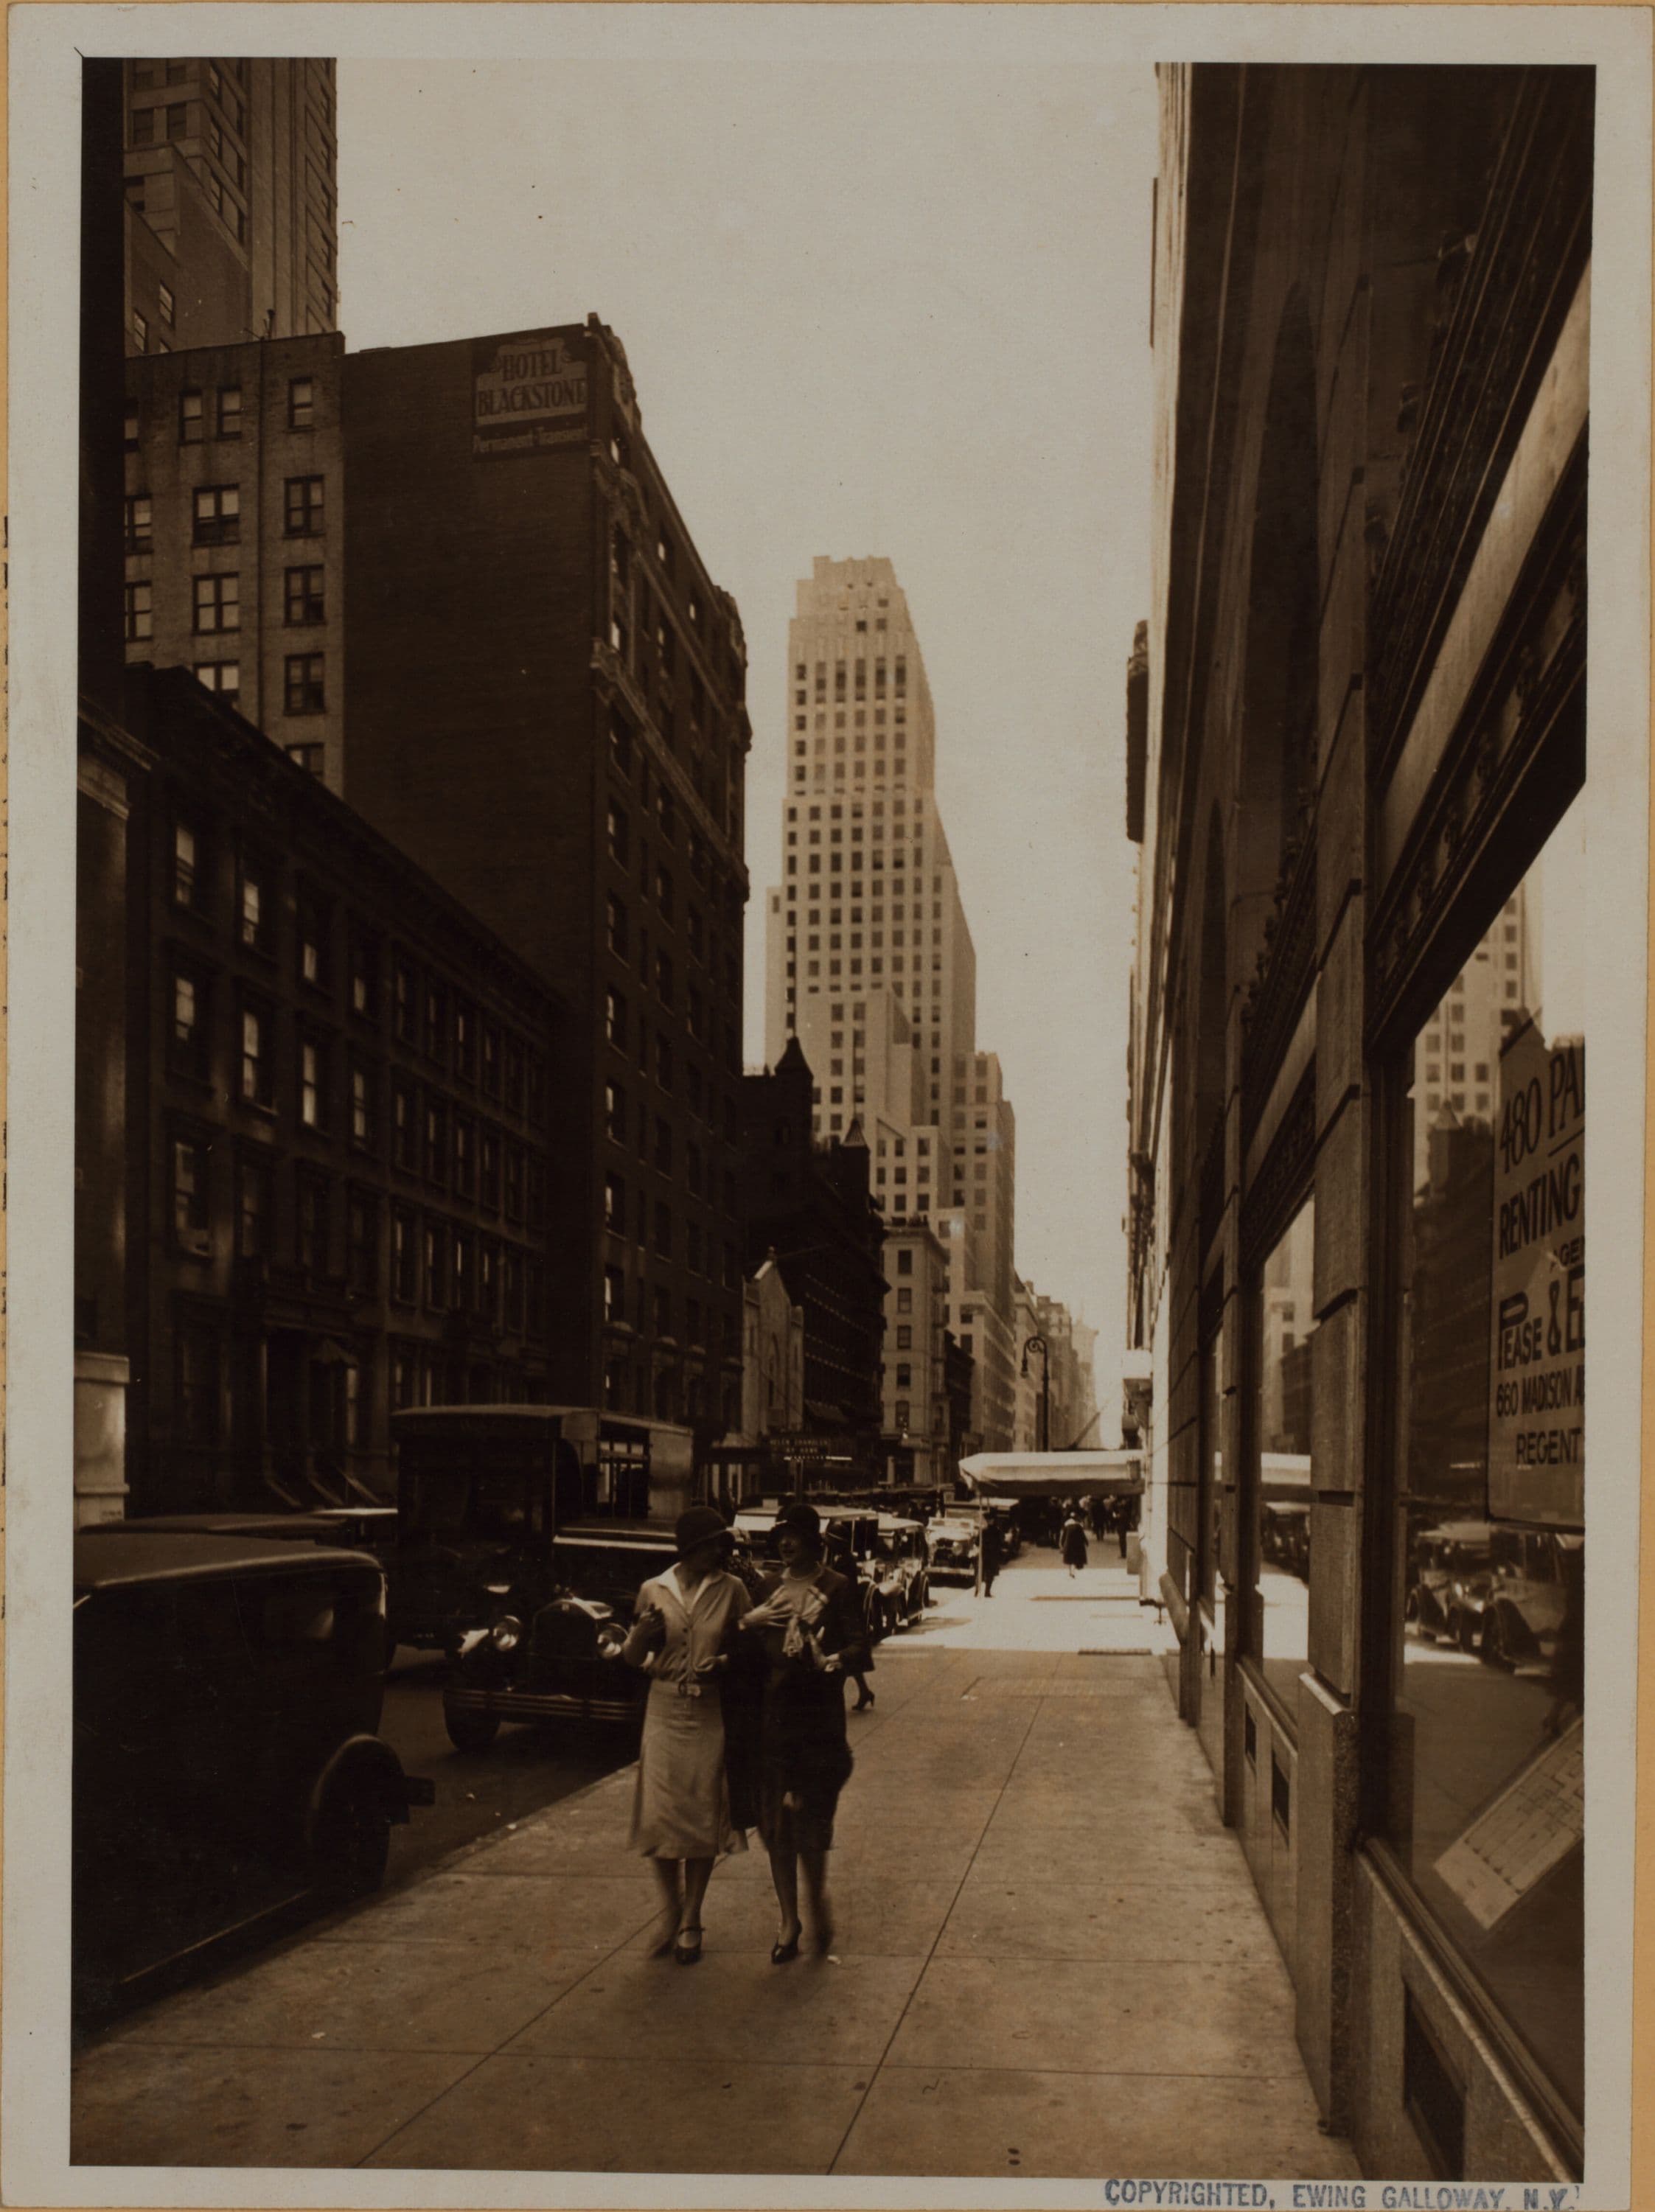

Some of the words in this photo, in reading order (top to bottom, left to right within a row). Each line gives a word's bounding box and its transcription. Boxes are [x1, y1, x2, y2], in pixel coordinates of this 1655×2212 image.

[502, 349, 562, 381] HOTEL
[477, 377, 587, 416] BLACKSTONE
[1499, 1077, 1541, 1173] 480
[1499, 1154, 1581, 1260] RENTING
[1547, 1280, 1561, 1357] &
[1497, 1381, 1518, 1417] 660
[1522, 1367, 1571, 1415] MADISON
[1517, 1427, 1582, 1465] REGENT
